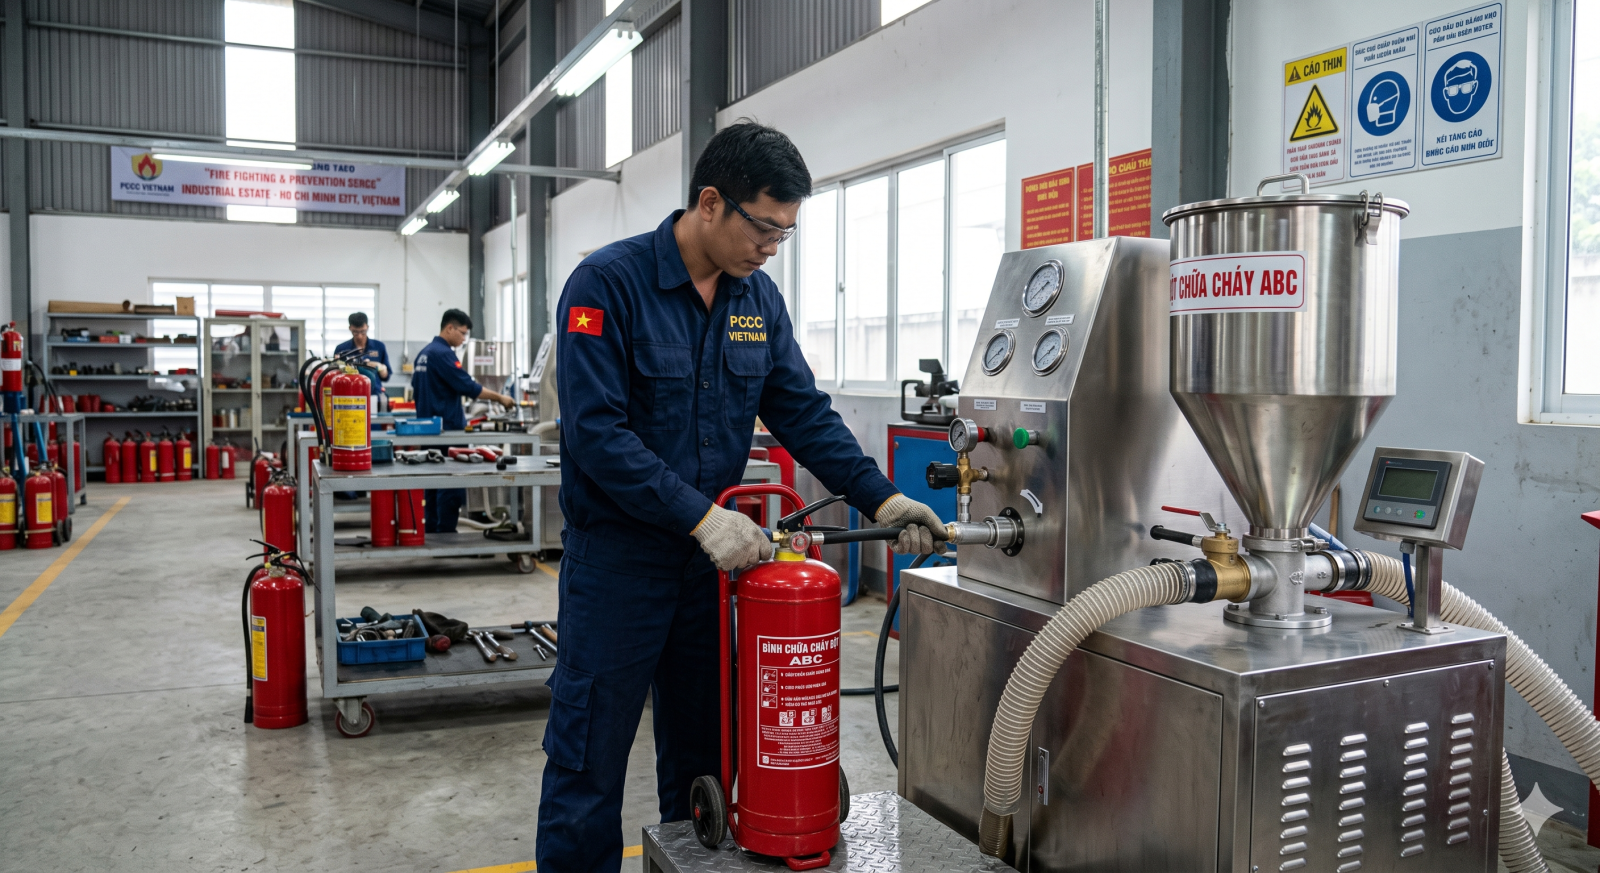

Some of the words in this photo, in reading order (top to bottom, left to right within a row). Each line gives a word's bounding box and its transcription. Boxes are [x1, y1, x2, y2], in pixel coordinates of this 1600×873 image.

[1304, 61, 1320, 77] CÁO
[120, 182, 141, 191] PCCC
[142, 183, 174, 192] VIETNAM
[234, 170, 276, 183] FIGHTING
[280, 174, 286, 184] &
[290, 175, 346, 188] PREVENTION
[182, 184, 235, 197] INDUSTRIAL
[239, 188, 270, 199] ESTATE
[280, 190, 292, 200] HO
[294, 192, 309, 201] CHI
[312, 192, 336, 203] MINH
[1179, 268, 1207, 300] CHỮA
[1212, 265, 1254, 297] CHÁY
[1260, 269, 1297, 295] ABC
[730, 316, 763, 328] PCCC
[728, 332, 766, 341] VIETNAM
[762, 641, 782, 654] BÌNH
[785, 641, 808, 654] CHỮA
[810, 638, 829, 652] CHÁY
[789, 655, 823, 665] ABC
